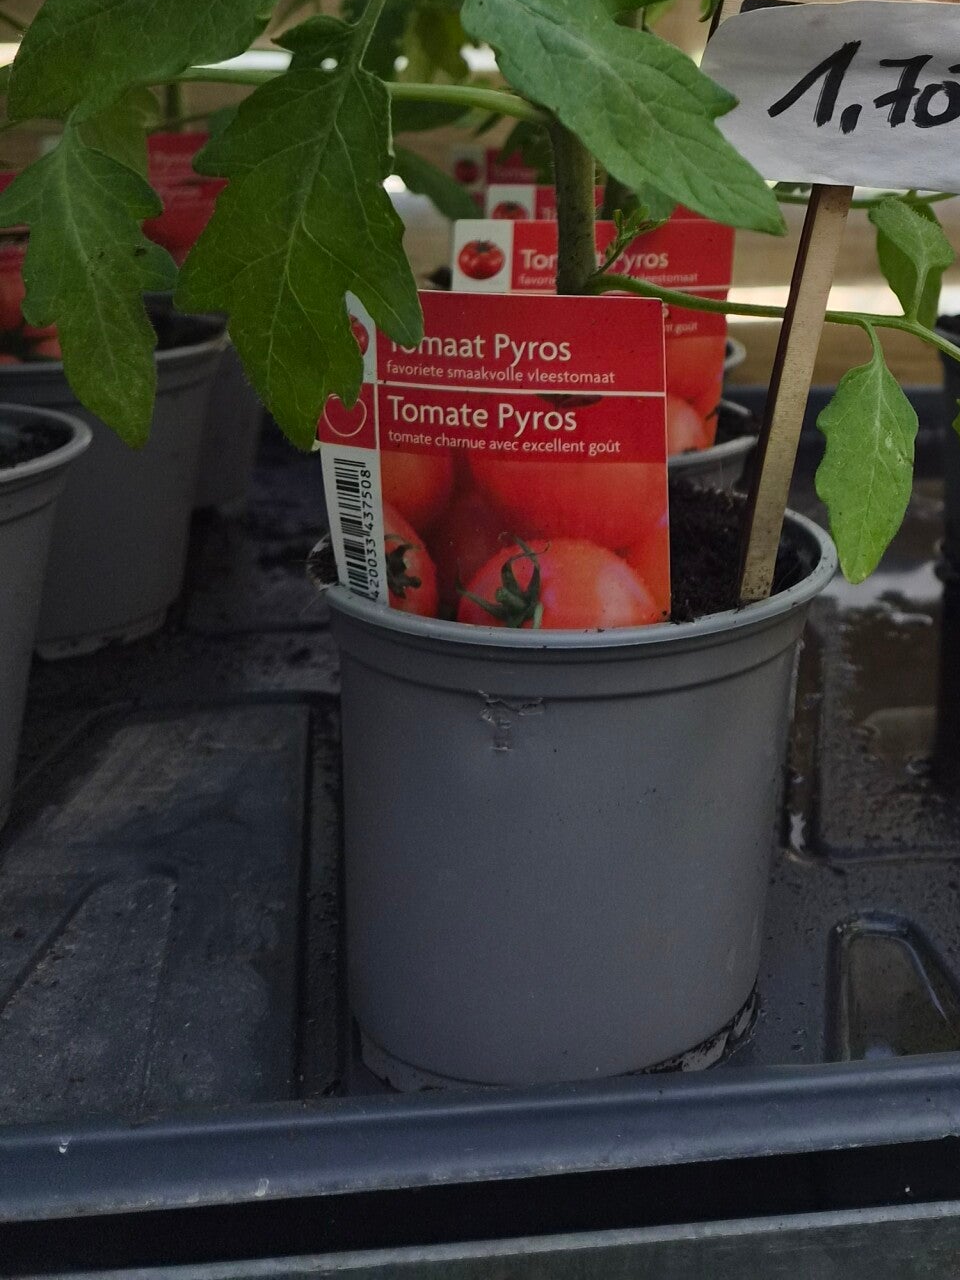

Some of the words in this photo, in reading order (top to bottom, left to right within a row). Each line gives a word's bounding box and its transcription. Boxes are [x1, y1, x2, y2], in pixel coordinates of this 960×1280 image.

[494, 333, 572, 367] Pyros
[386, 359, 444, 377] favoriete
[447, 365, 523, 382] smaakvolle
[527, 368, 616, 384] vleestomaat
[386, 395, 489, 428] Tomate
[498, 403, 577, 438] Pyros
[388, 430, 433, 445] tomate
[435, 433, 486, 450] charnue
[488, 439, 519, 451] avec
[522, 437, 585, 453] excellent
[588, 438, 621, 457] goût
